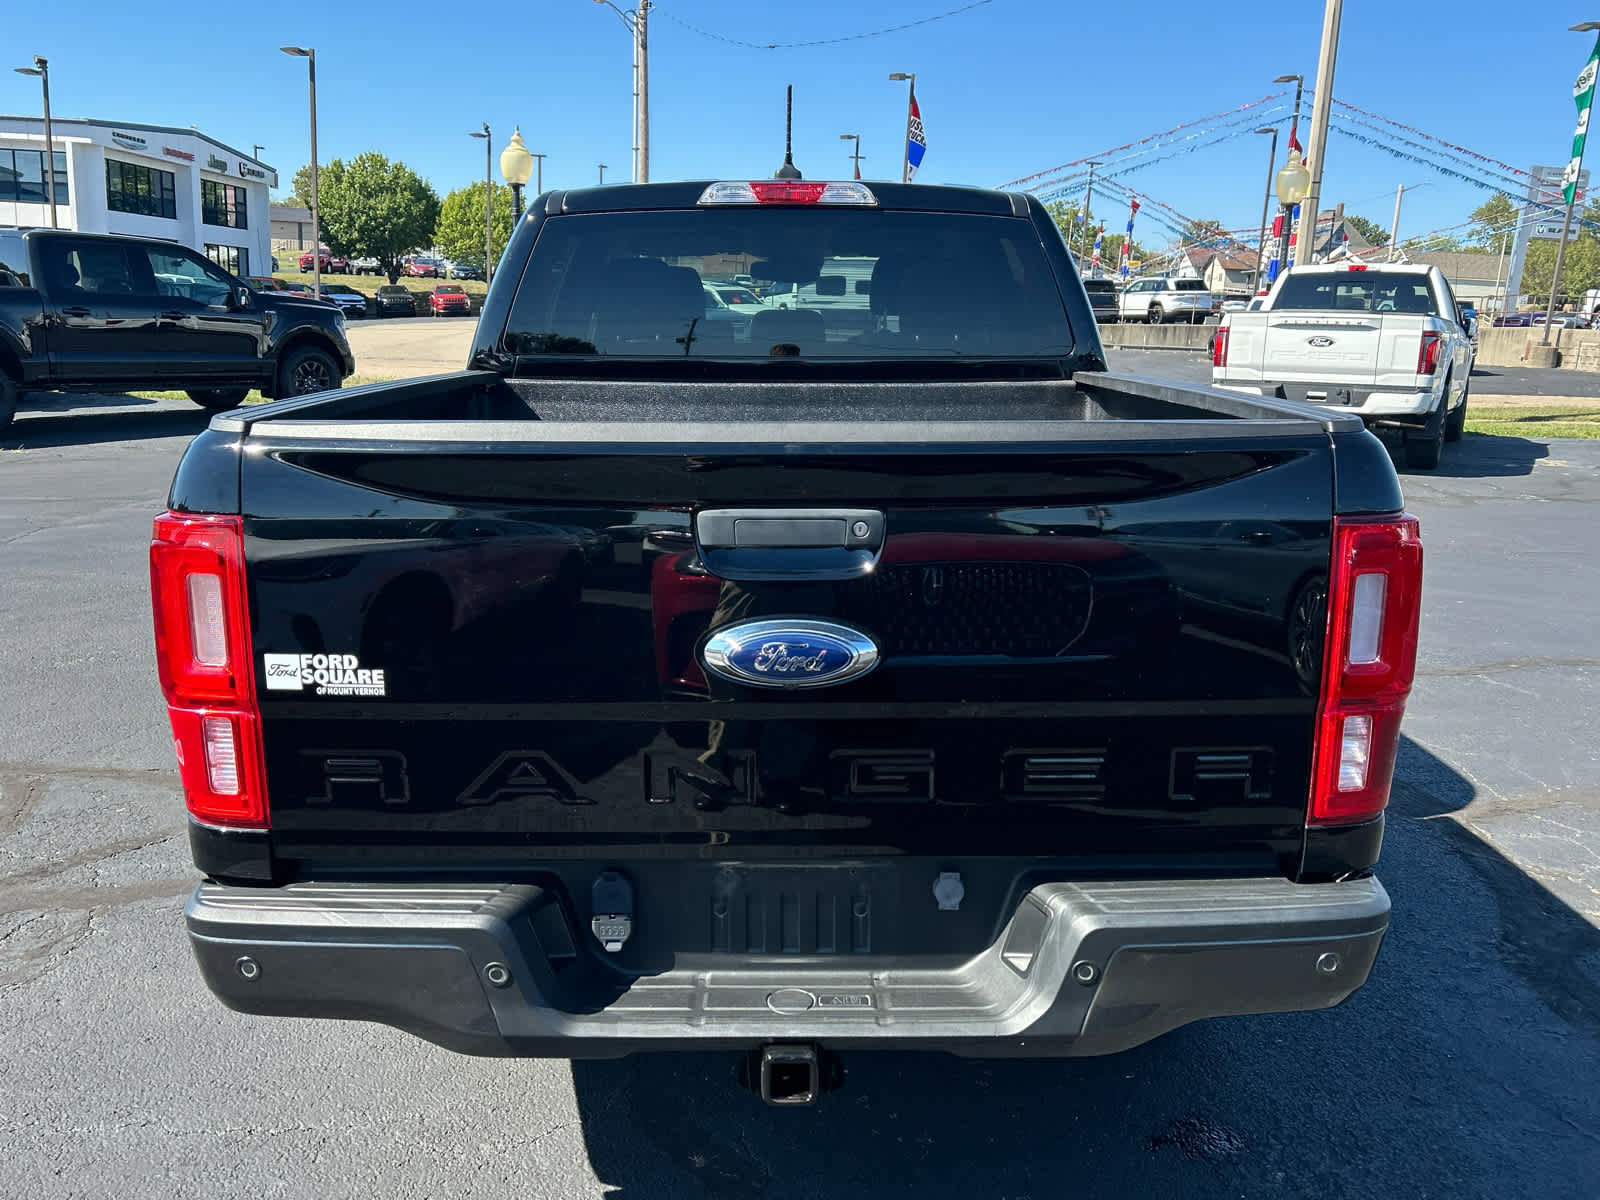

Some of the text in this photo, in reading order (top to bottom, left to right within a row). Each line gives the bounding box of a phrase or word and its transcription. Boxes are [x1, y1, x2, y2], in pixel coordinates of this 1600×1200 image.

[300, 654, 358, 669] FORD
[754, 642, 827, 671] Ford
[267, 663, 298, 677] Ford
[301, 669, 384, 686] SQUARE
[316, 687, 385, 696] OF MOUNT VERNON
[298, 747, 1276, 806] RANGER
